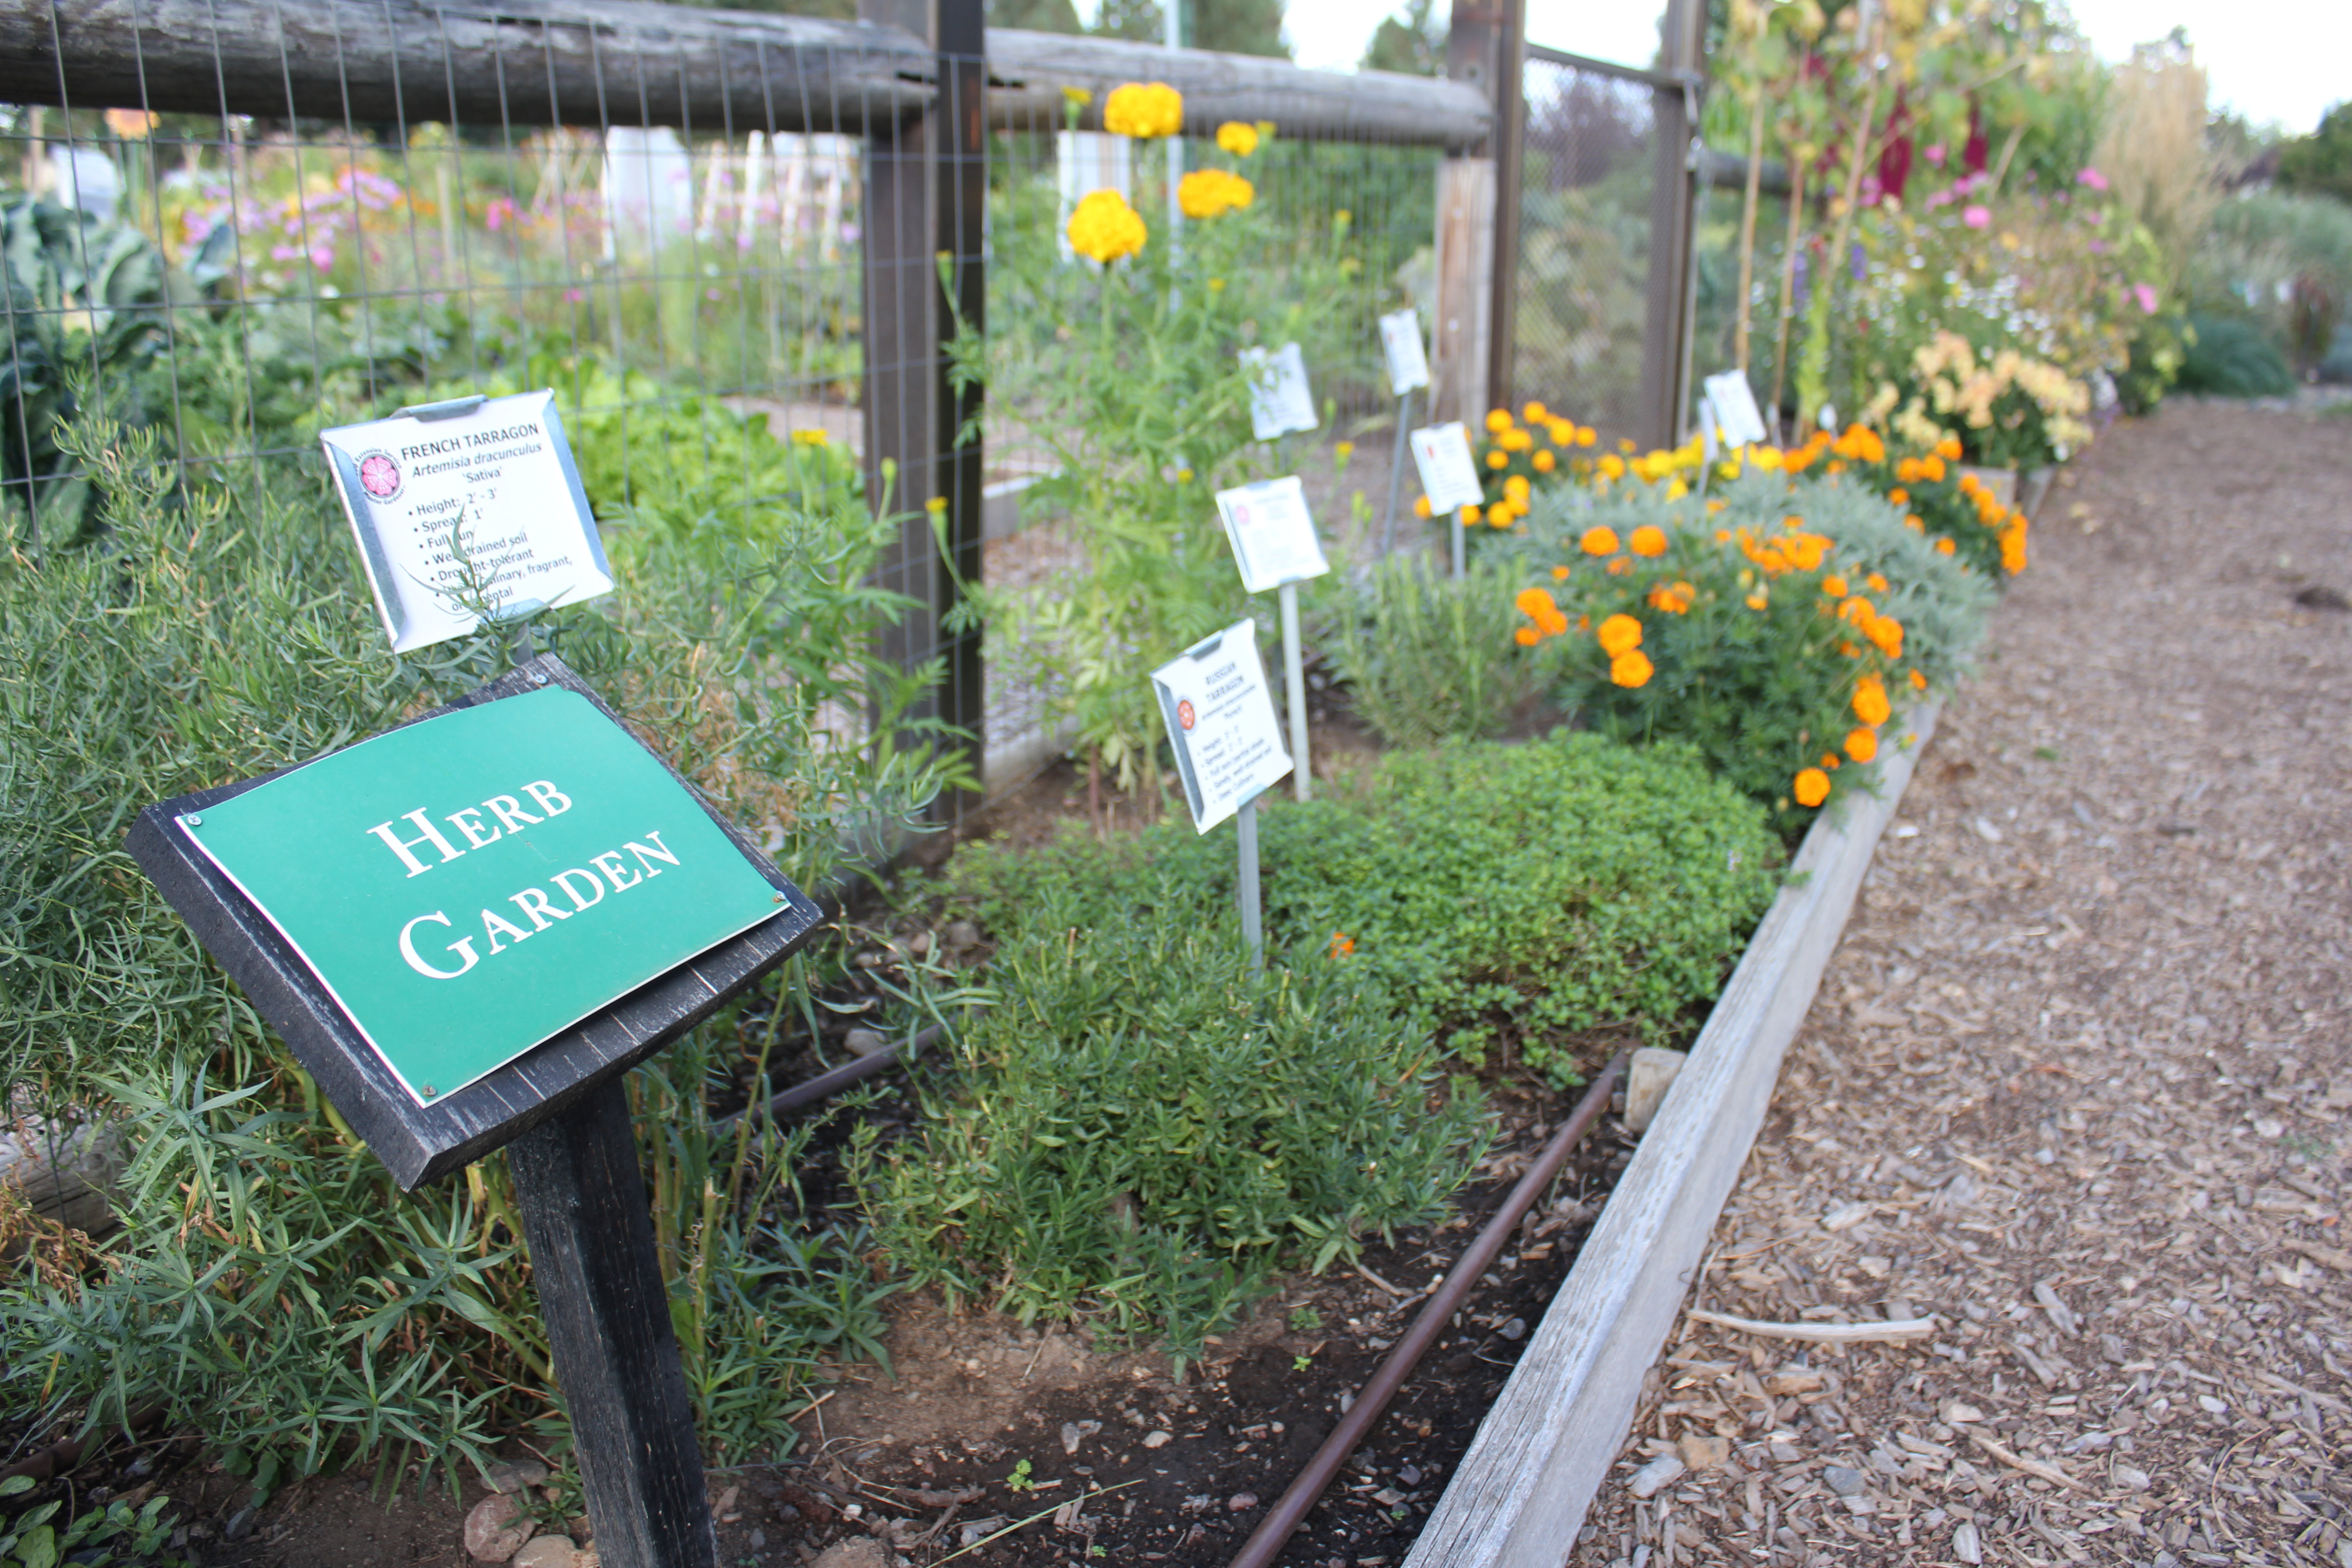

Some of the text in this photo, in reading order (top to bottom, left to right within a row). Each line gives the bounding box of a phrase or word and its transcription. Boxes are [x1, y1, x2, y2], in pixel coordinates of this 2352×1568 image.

[401, 423, 539, 460] FRENCH TARRAGON
[412, 443, 542, 477] Artemisia dracunculus
[416, 498, 461, 515] Height:
[466, 492, 475, 504] 2'
[487, 488, 496, 500] 3'
[421, 513, 468, 533] Sprea:
[455, 529, 473, 542] un
[509, 531, 529, 546] soil
[438, 548, 534, 581] Drouht-tolerant
[527, 555, 573, 574] fragrant,
[452, 586, 513, 611] orental
[1205, 661, 1236, 686] RUSSIAN
[1206, 675, 1244, 703] TARRAGON
[366, 779, 573, 878] HERB
[399, 830, 681, 979] GARDEN
